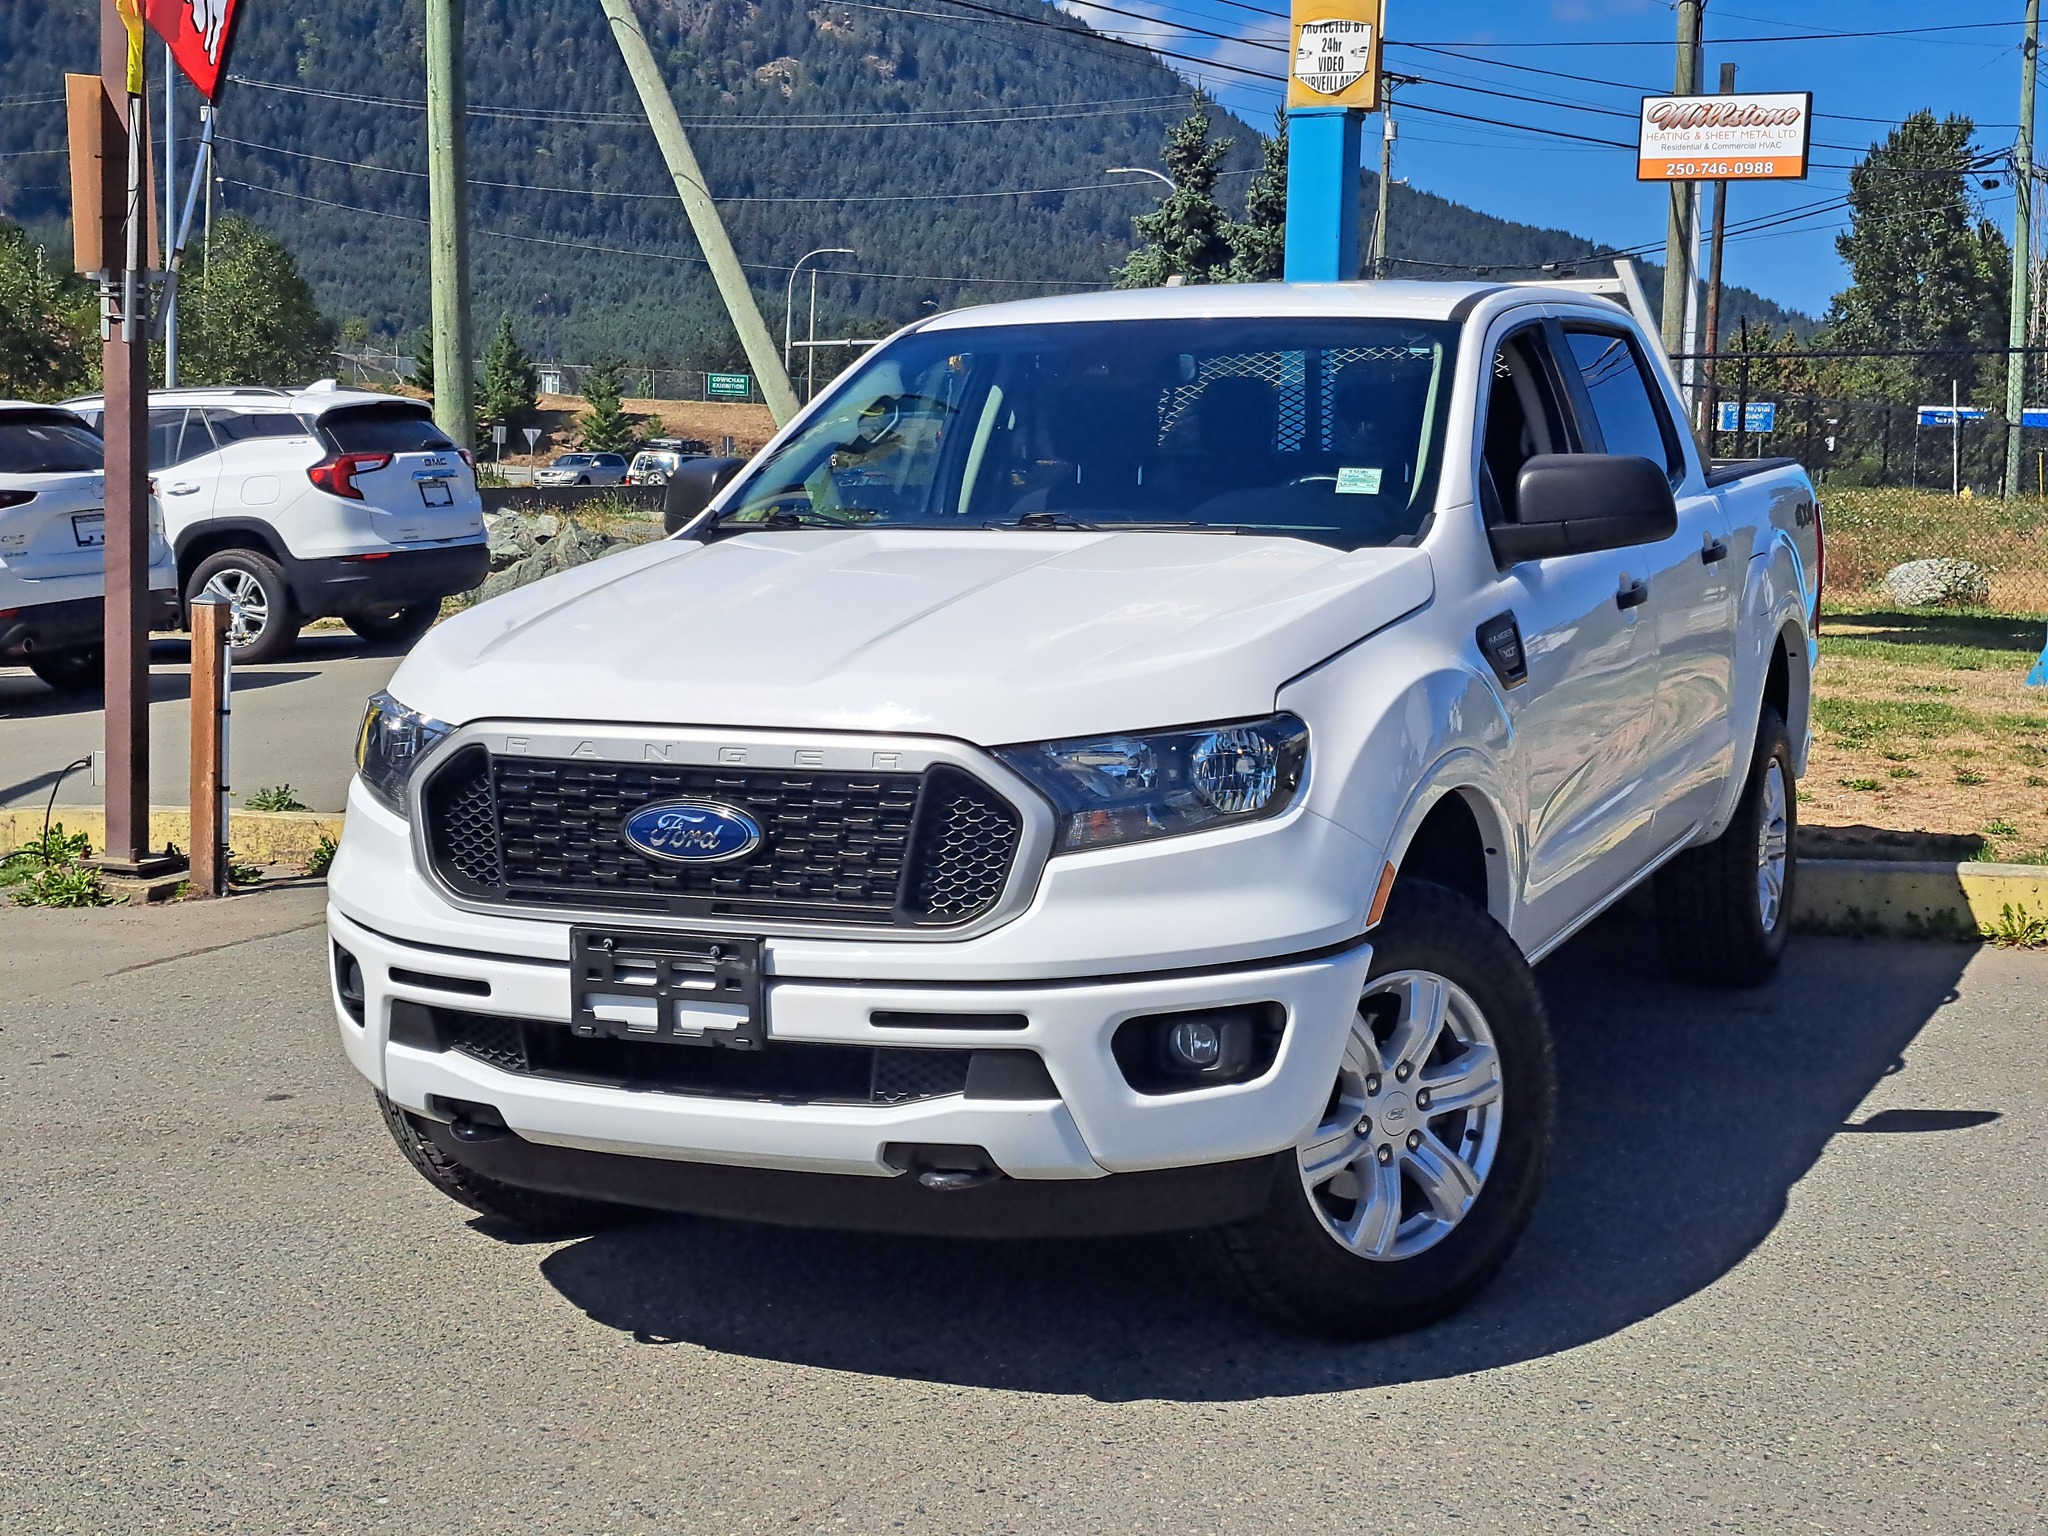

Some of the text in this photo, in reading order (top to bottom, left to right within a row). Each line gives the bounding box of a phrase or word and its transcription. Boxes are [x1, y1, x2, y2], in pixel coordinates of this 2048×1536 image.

[1321, 37, 1342, 53] 24hr
[1318, 56, 1344, 72] VIDEO
[1646, 101, 1801, 131] Millstone
[1646, 132, 1690, 141] HEATING
[1694, 131, 1701, 140] &
[1705, 131, 1737, 140] SHEET
[1740, 130, 1773, 139] METAL
[1661, 143, 1702, 151] Residential
[1712, 141, 1757, 150] Commercial
[1758, 141, 1782, 149] HVAC
[1665, 161, 1774, 176] 250-746-0988
[424, 458, 447, 467] GMC
[505, 735, 902, 769] RANGER
[650, 813, 724, 850] Ford
